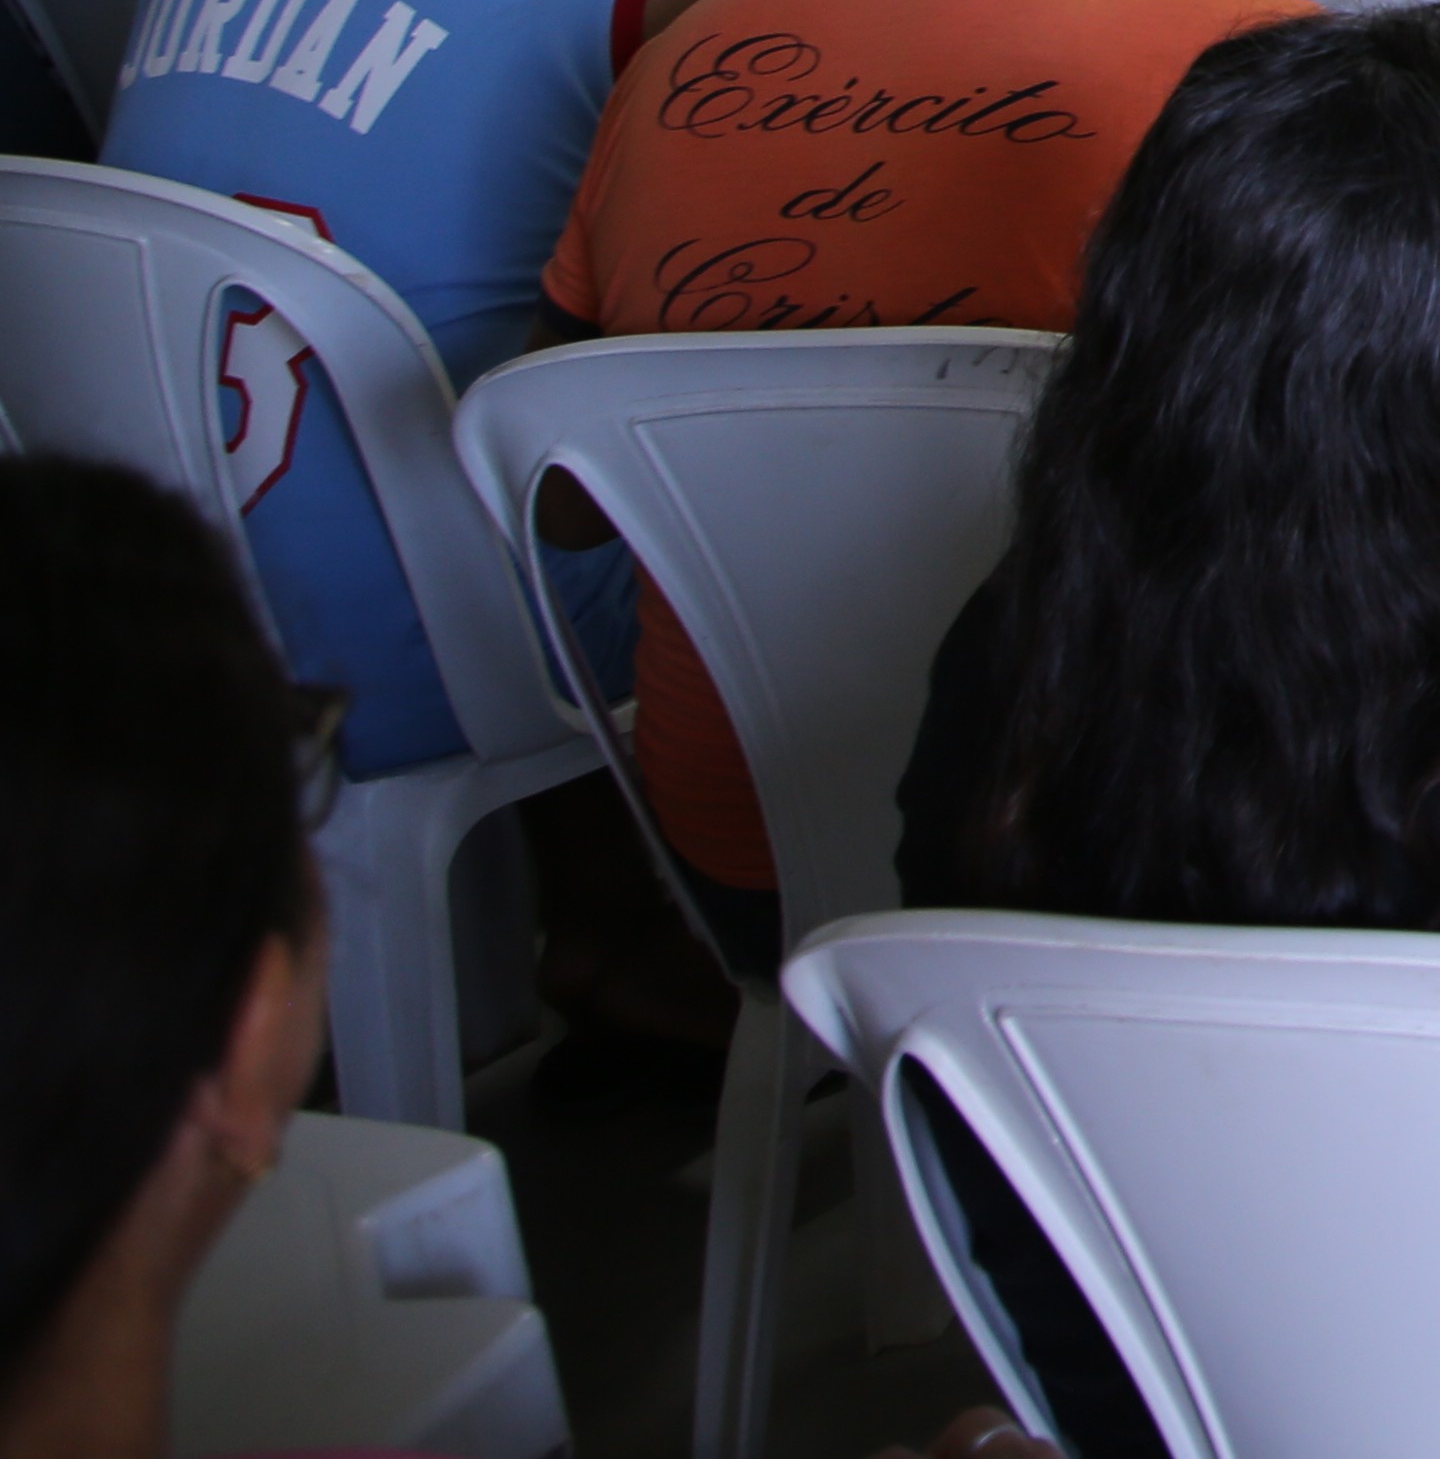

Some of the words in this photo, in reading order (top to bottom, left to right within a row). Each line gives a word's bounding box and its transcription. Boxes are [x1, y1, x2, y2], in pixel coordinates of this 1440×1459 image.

[657, 33, 1098, 143] Exército
[779, 160, 905, 223] de
[654, 237, 1015, 333] Crist
